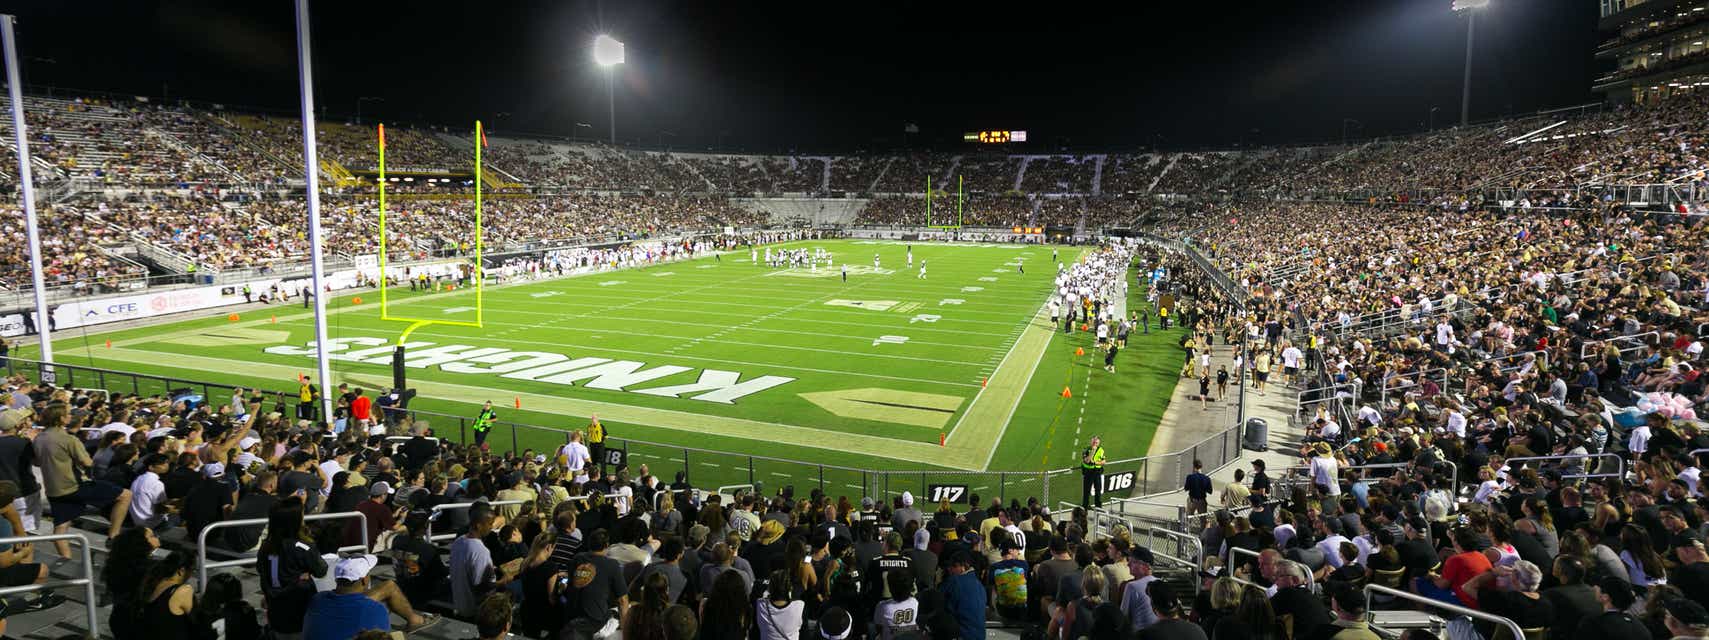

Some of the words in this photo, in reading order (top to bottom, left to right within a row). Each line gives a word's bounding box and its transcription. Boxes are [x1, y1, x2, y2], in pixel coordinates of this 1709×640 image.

[107, 303, 137, 314] CFE
[262, 337, 798, 404] KNIGHTS
[605, 450, 621, 464] 18
[1108, 472, 1133, 491] 116
[932, 486, 965, 502] 117
[879, 559, 908, 568] KNIGHTS
